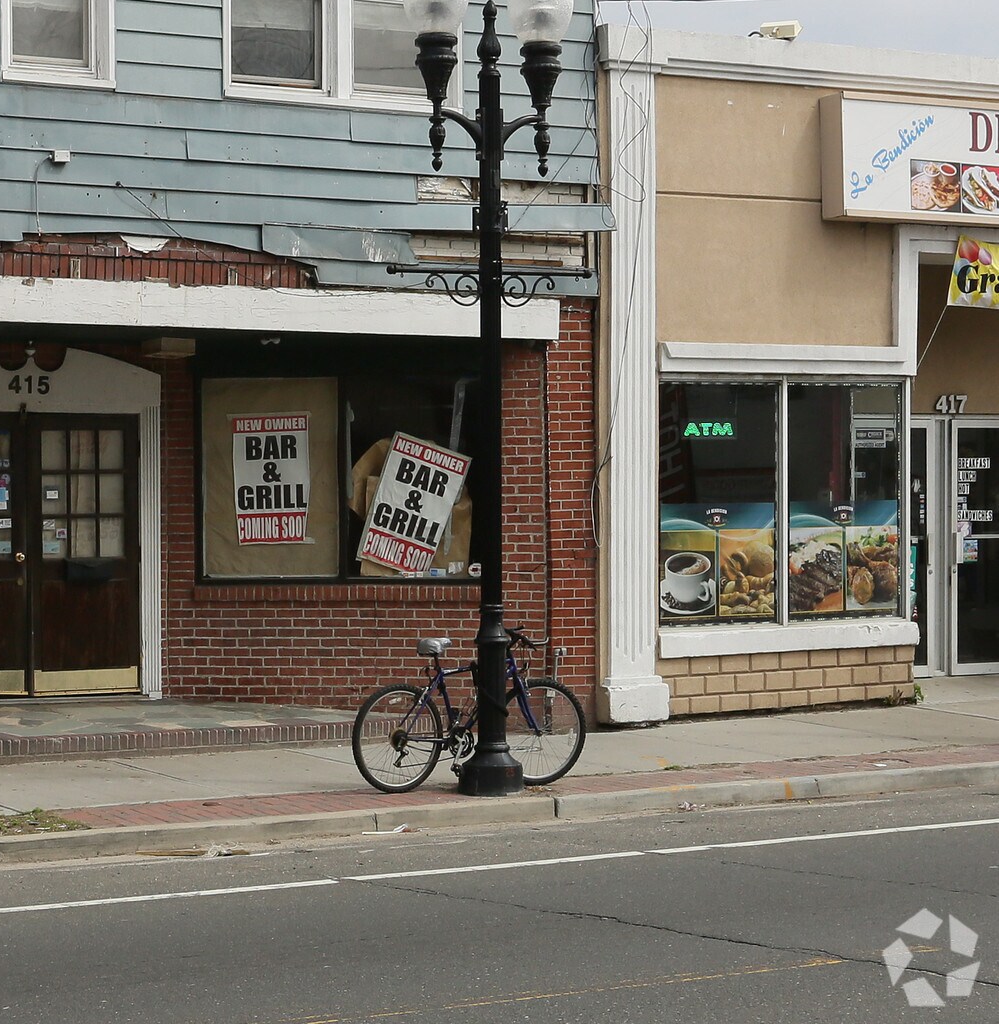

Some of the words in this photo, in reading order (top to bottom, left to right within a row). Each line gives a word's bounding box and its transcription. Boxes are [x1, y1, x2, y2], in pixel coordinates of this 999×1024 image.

[968, 112, 999, 154] D
[850, 171, 873, 199] La
[8, 375, 50, 395] 415
[936, 395, 968, 414] 417
[236, 419, 262, 431] NEW
[264, 417, 306, 431] OWNER
[683, 422, 733, 436] ATM
[245, 435, 297, 461] BAR
[396, 439, 423, 457] NEW
[424, 449, 464, 473] OWNER
[262, 461, 281, 483] &
[958, 458, 990, 469] BREAKFAST
[395, 457, 449, 497] BAR
[958, 471, 976, 482] LUNCH
[237, 484, 308, 510] GRILL
[404, 490, 423, 513] &
[373, 503, 440, 547] GRILL
[957, 510, 992, 521] SANDWICHES
[238, 516, 279, 540] COMING
[362, 531, 405, 567] COMING
